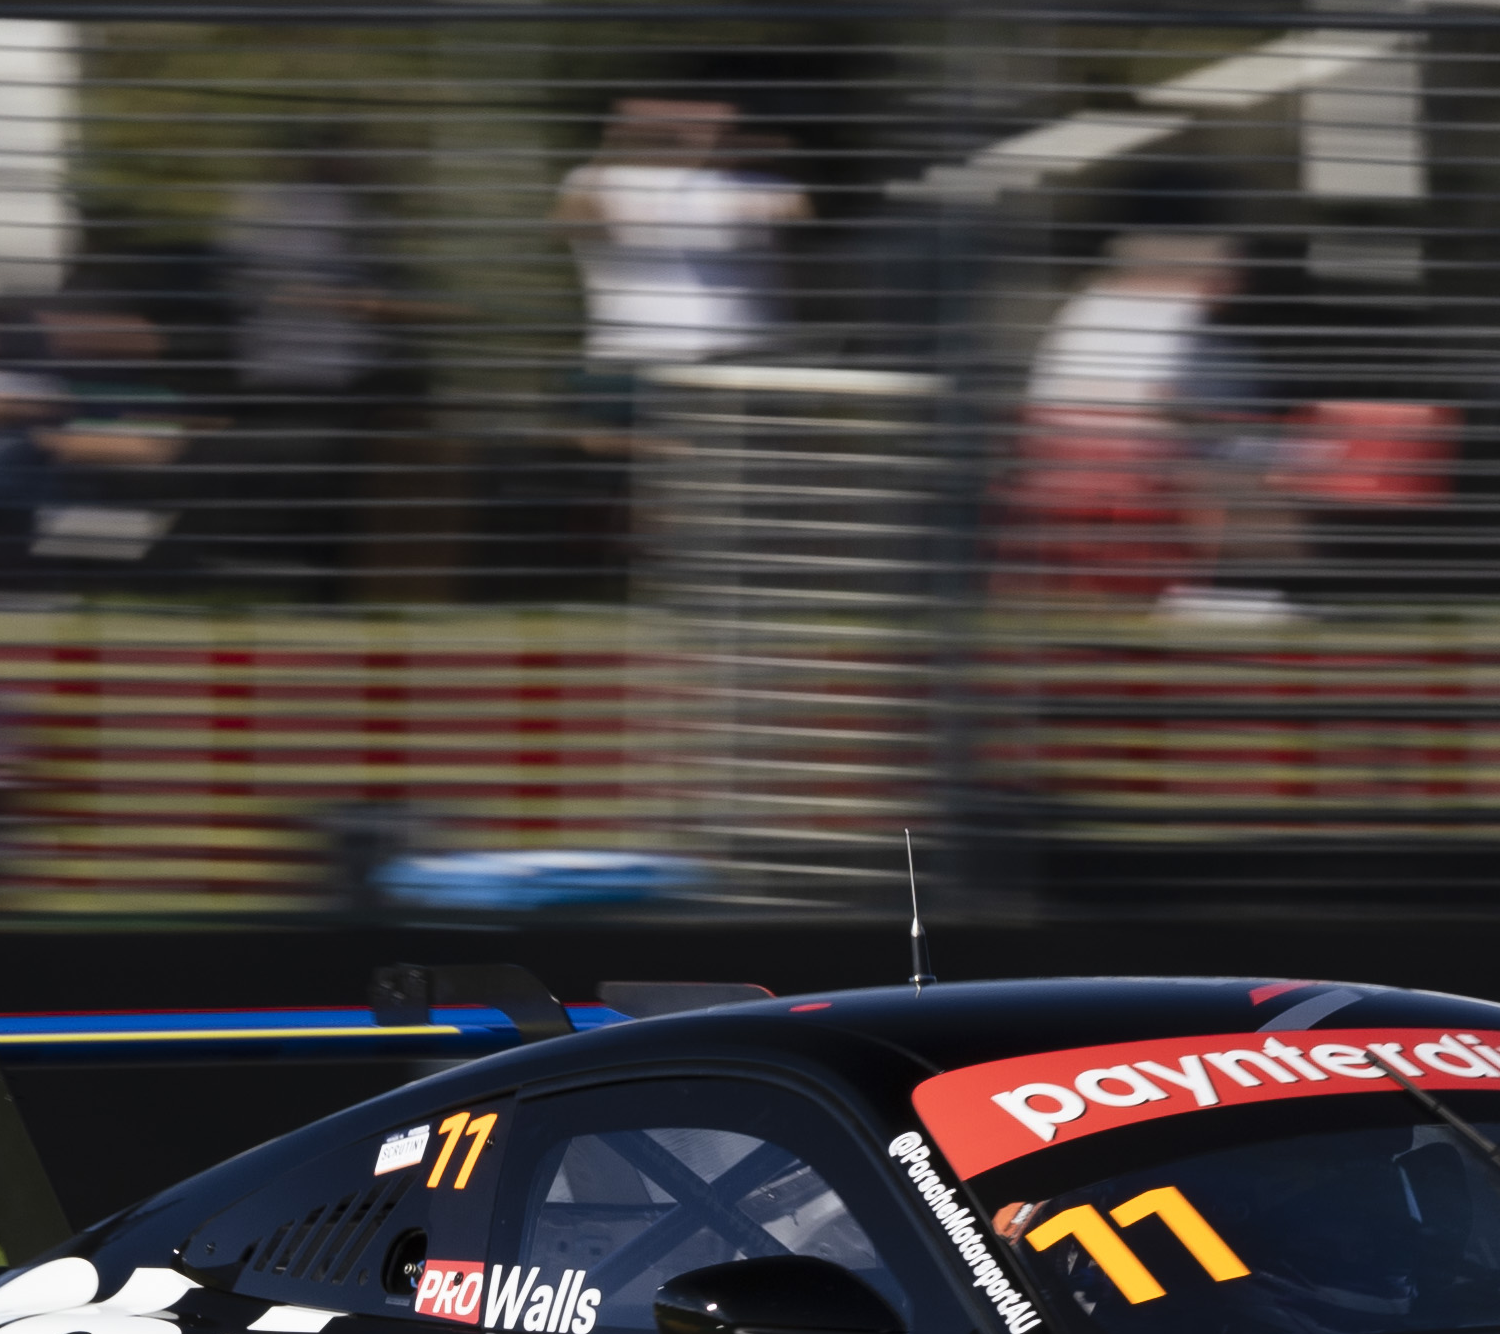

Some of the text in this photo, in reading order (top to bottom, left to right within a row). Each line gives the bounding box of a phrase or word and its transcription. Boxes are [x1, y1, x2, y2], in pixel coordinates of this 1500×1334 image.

[426, 1111, 498, 1190] 11
[1024, 1185, 1252, 1305] 11
[414, 1269, 485, 1316] PRO
